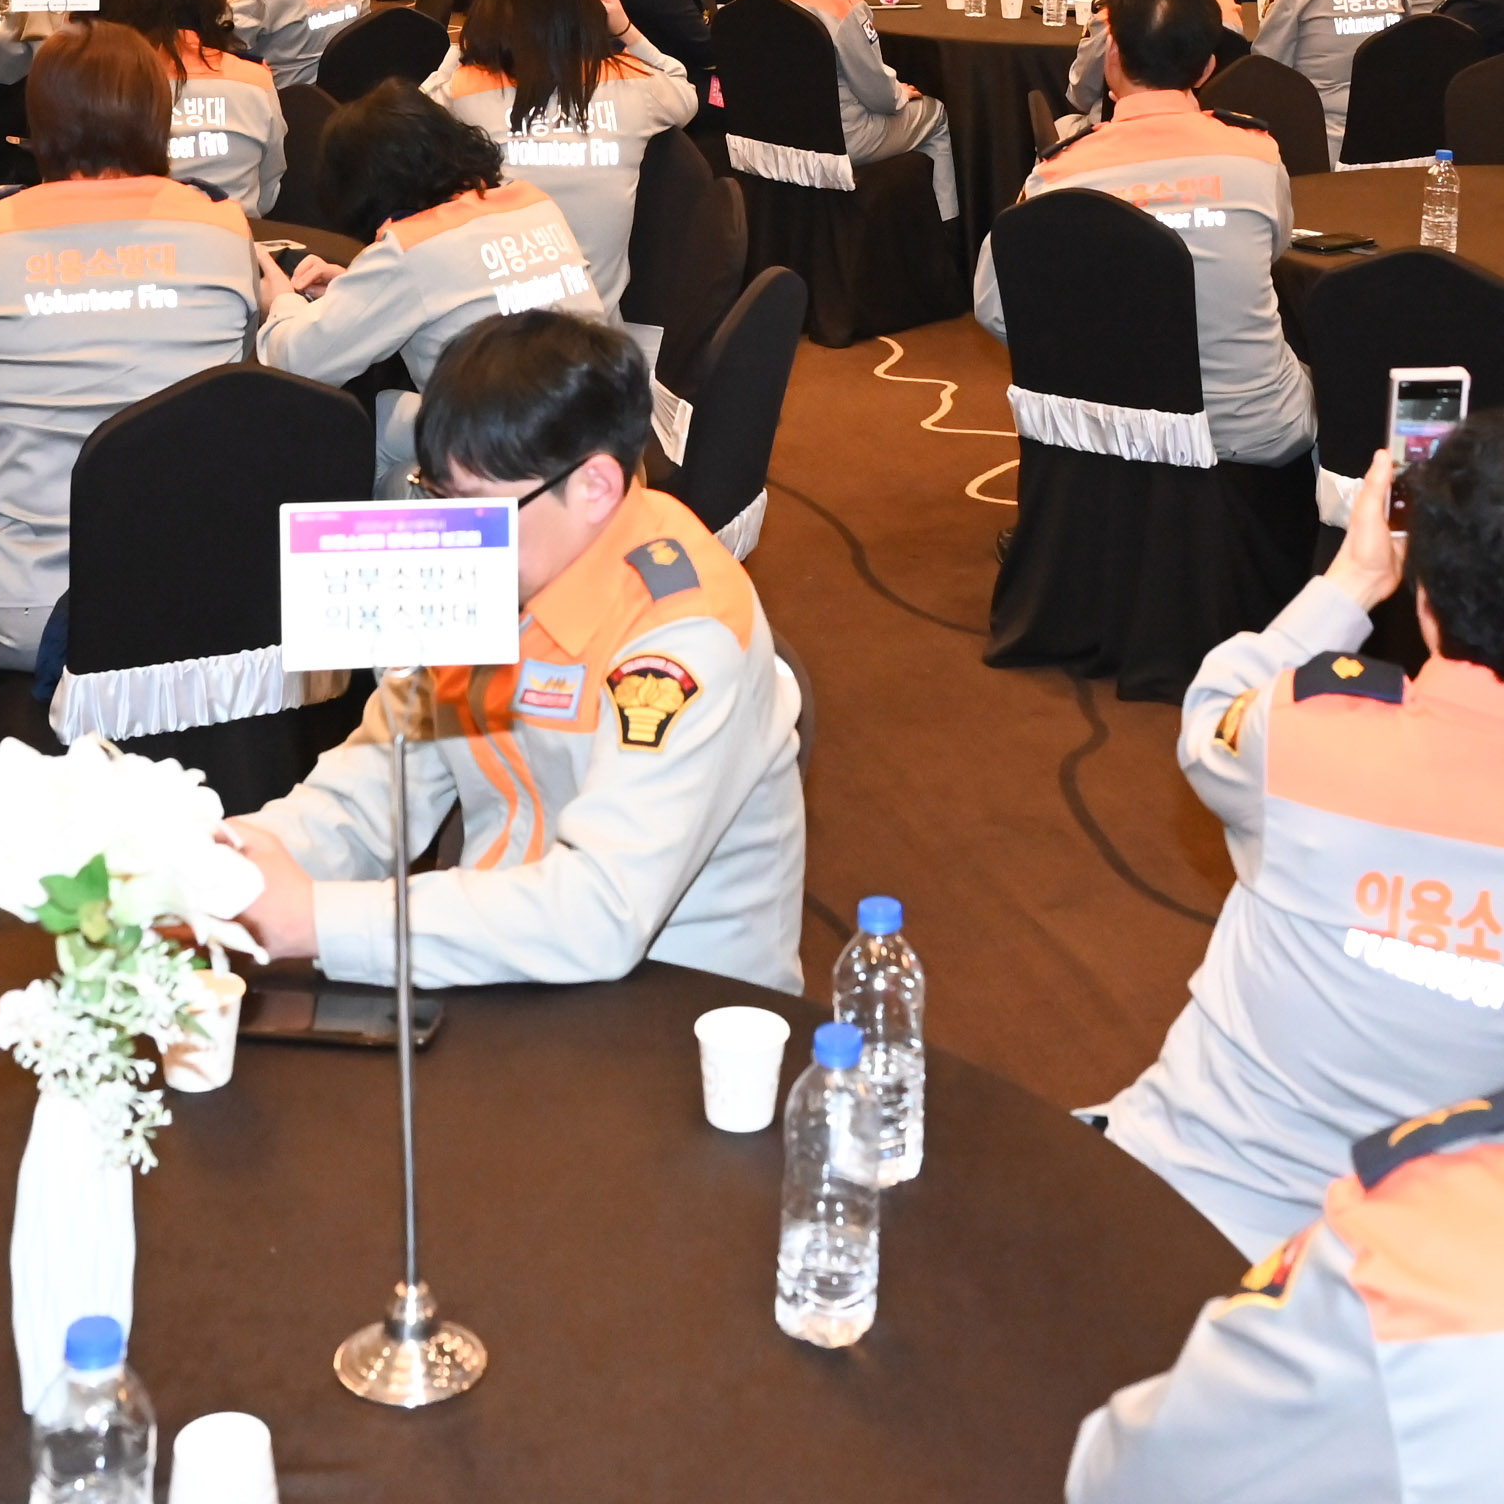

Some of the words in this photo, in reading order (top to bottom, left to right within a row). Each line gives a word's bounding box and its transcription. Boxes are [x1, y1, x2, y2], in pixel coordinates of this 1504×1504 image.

[1333, 15, 1385, 35] Volunteer
[198, 131, 228, 156] Fire
[507, 138, 588, 166] Volunteer
[590, 139, 620, 166] Fire
[1194, 207, 1226, 228] Fire
[25, 244, 177, 285] 의용소방대
[25, 288, 132, 316] Volunteer
[137, 284, 178, 310] Fire
[493, 270, 564, 316] Volunteer
[323, 566, 478, 595] 남부소방서
[325, 602, 480, 632] 의용소방대
